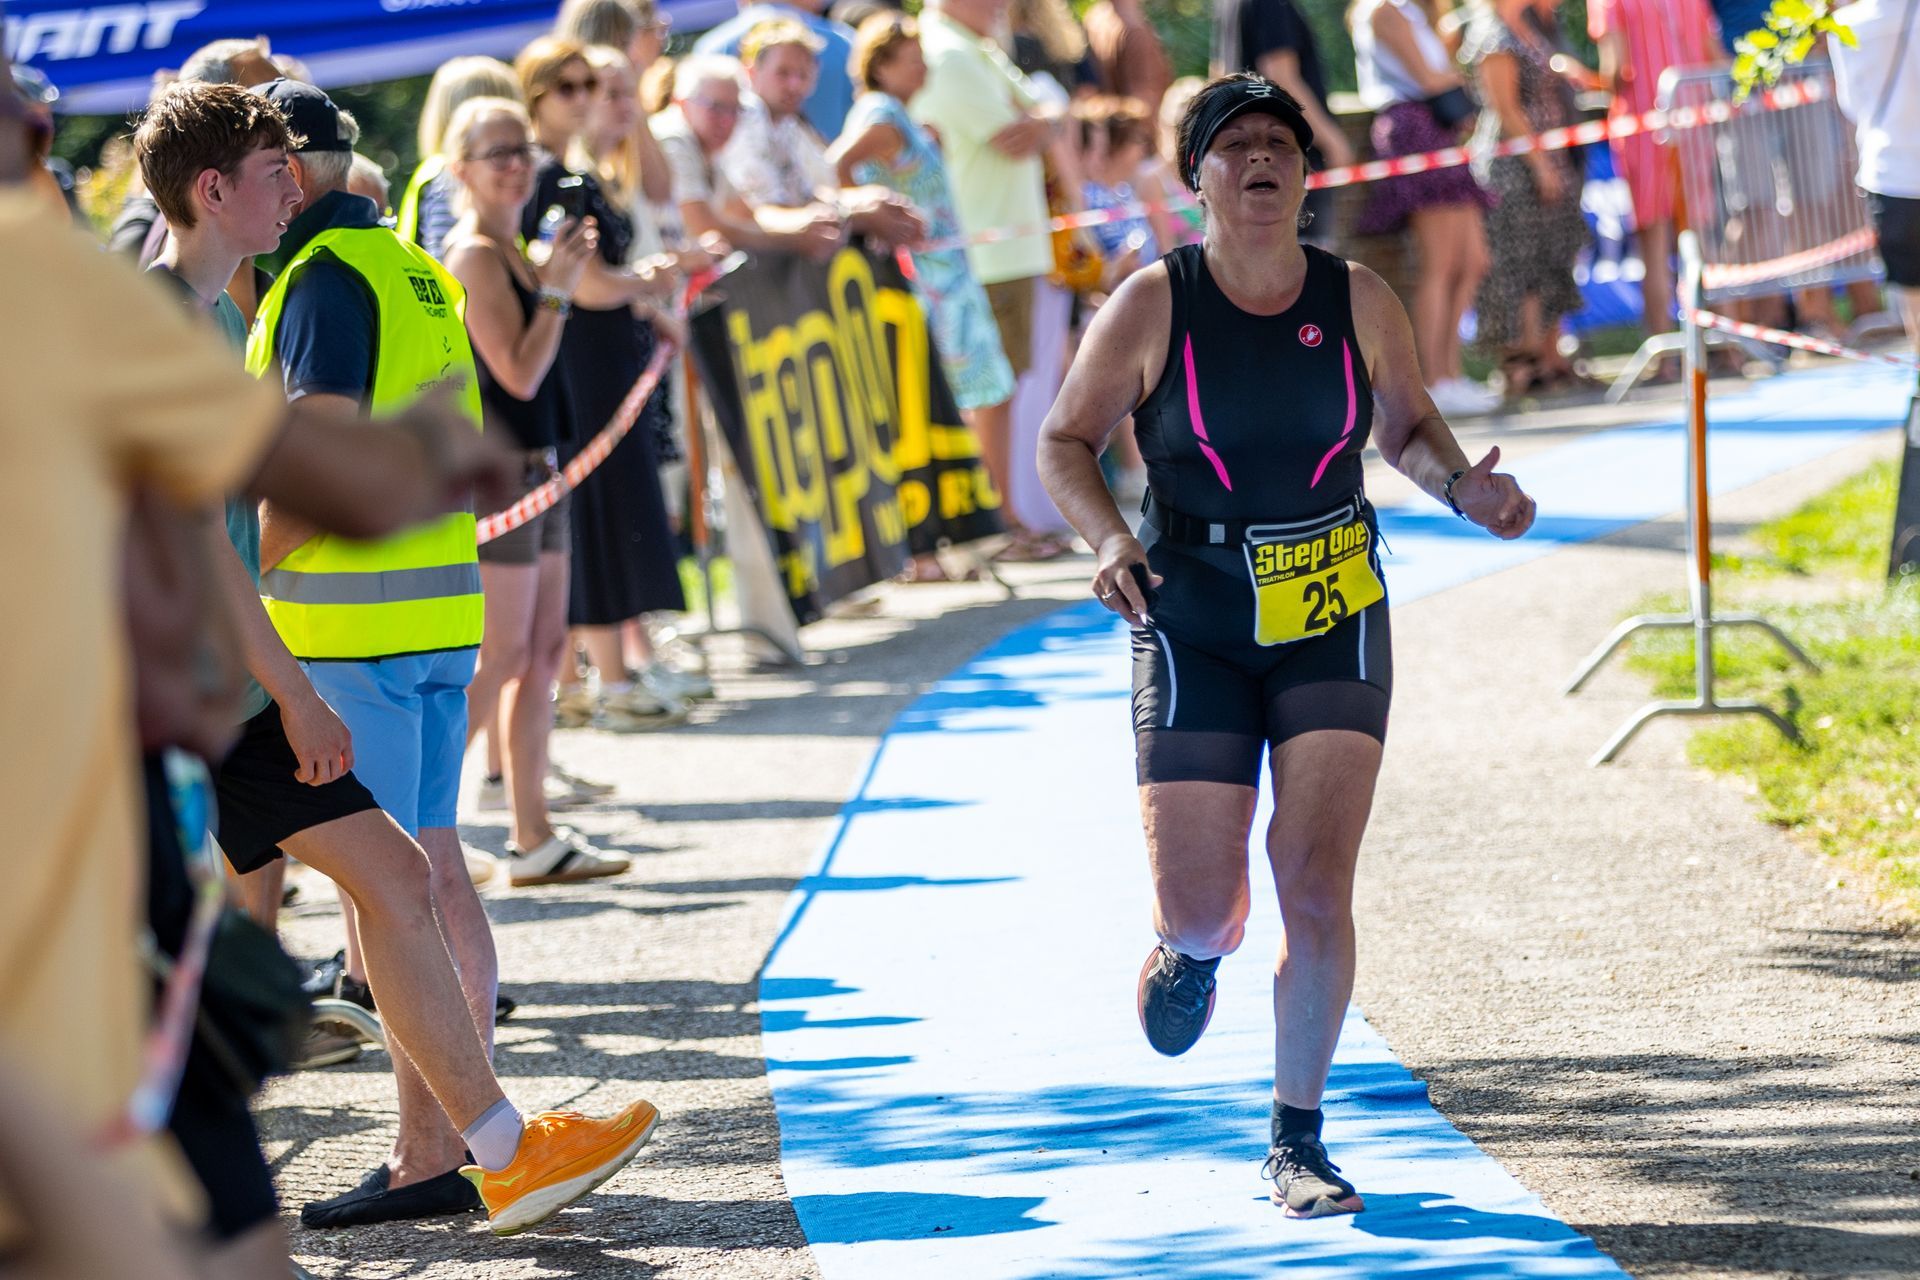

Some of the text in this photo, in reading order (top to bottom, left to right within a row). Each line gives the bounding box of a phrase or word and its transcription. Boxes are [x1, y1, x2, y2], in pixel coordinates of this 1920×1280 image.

[1255, 522, 1367, 576] Step One
[1257, 570, 1296, 585] TRIATHLON
[1302, 571, 1349, 632] 25
